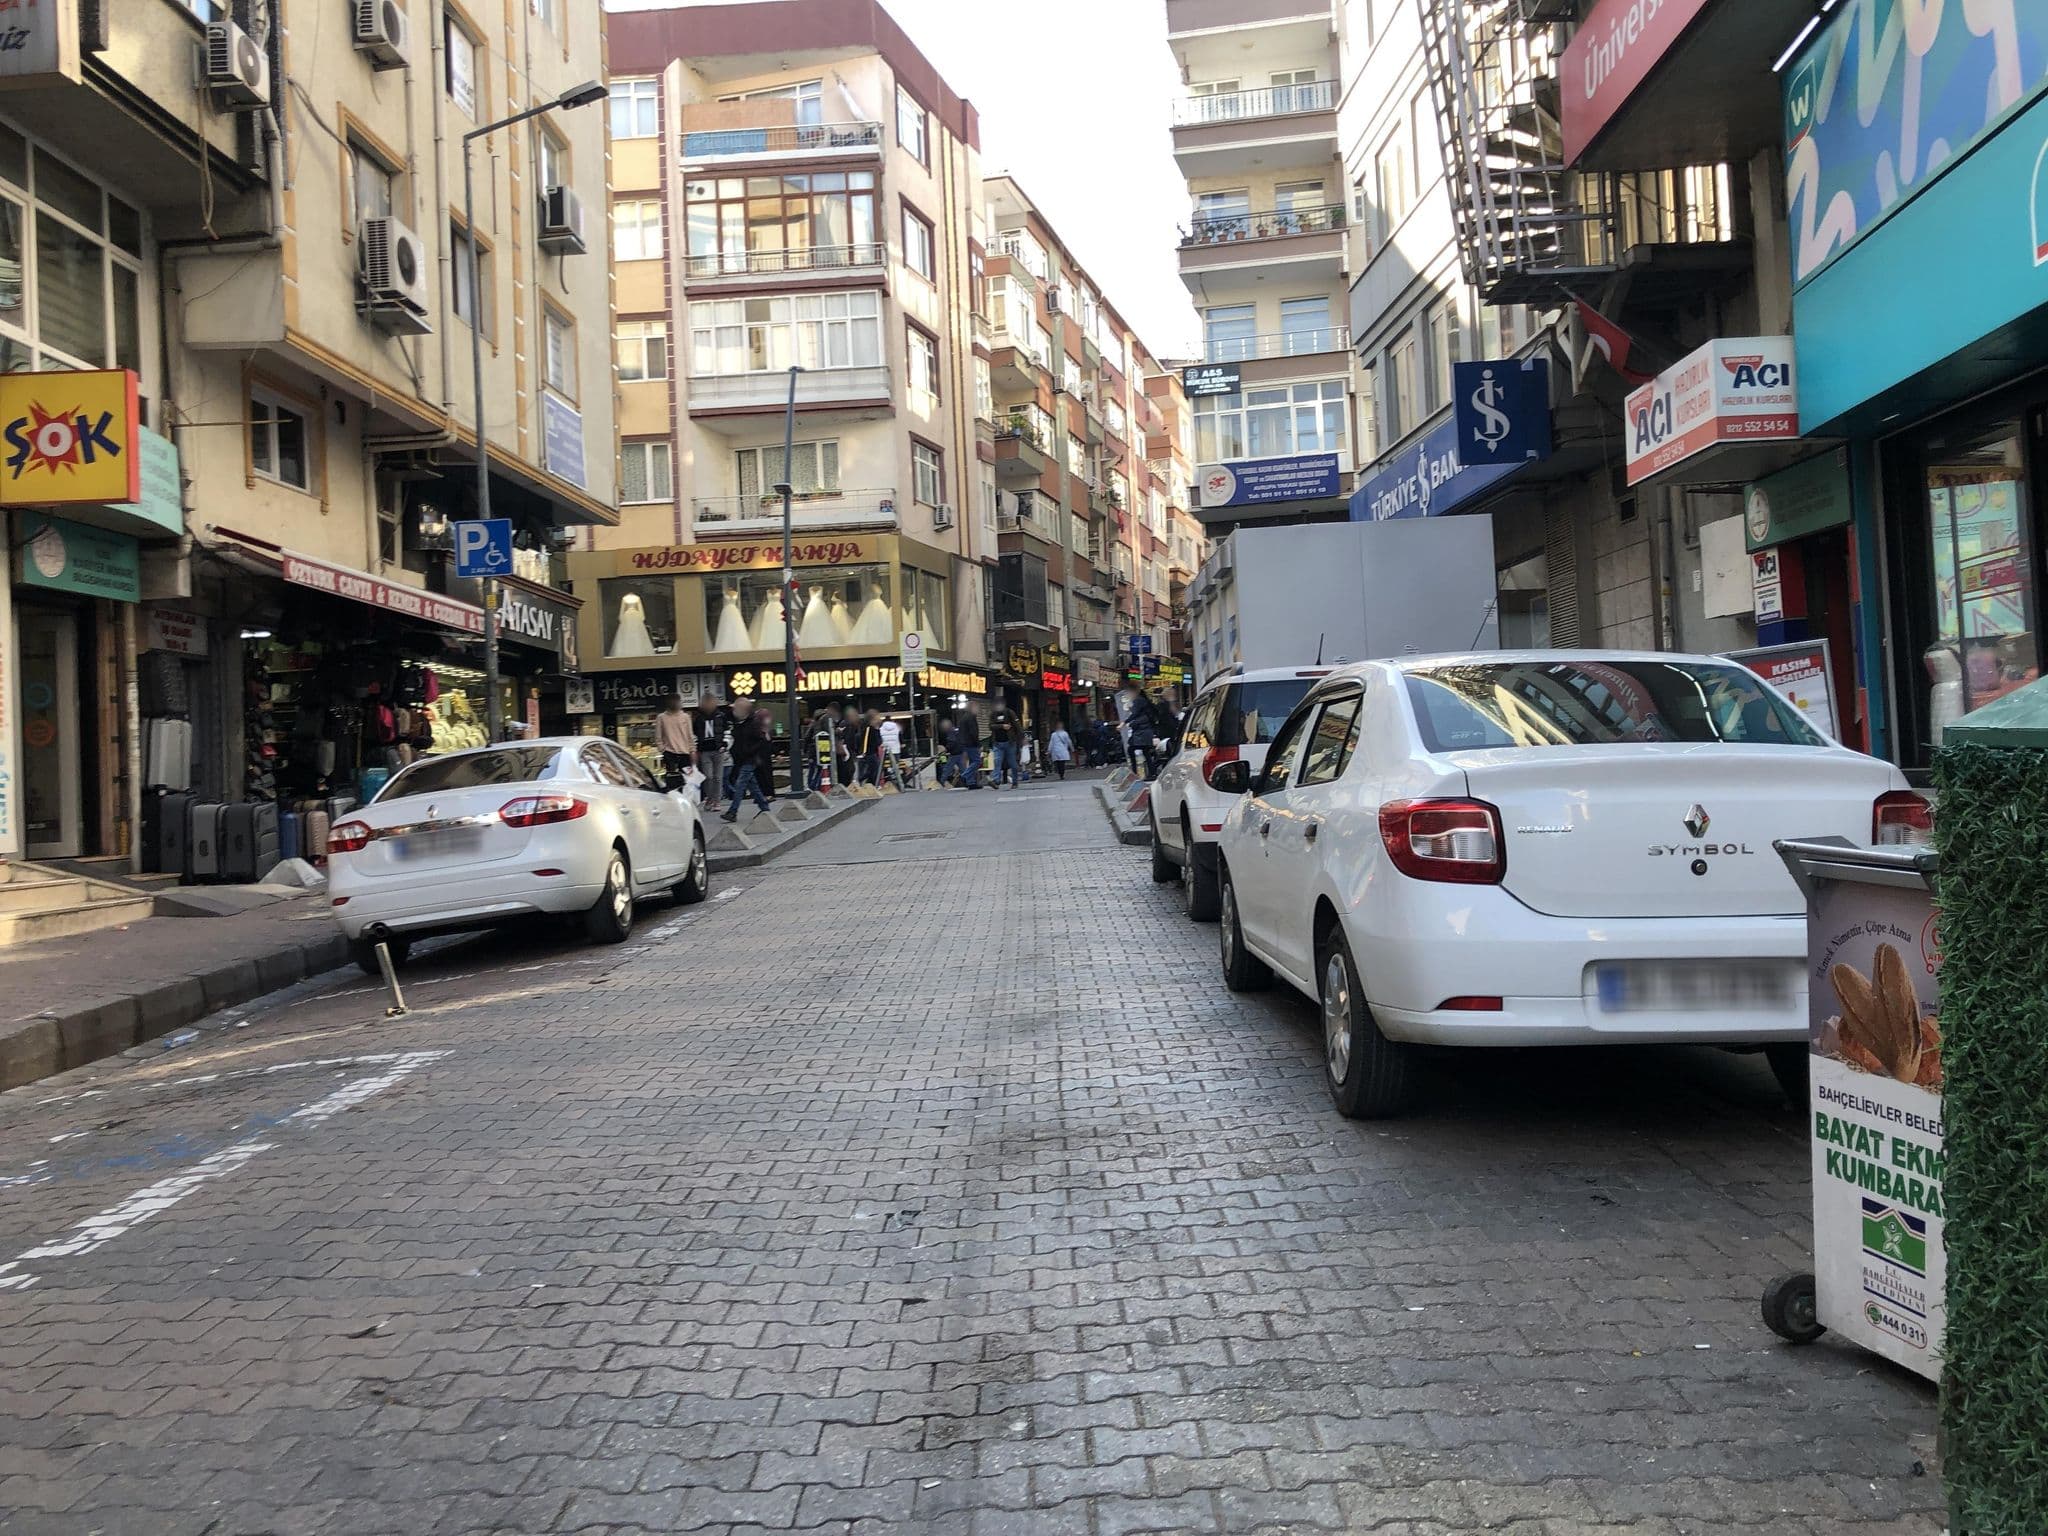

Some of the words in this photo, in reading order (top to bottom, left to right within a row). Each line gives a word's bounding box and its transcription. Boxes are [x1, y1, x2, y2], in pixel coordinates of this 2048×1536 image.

[1584, 0, 1663, 99] Ünivers
[1202, 368, 1223, 378] A&S
[1733, 363, 1790, 389] AÇI
[1635, 391, 1673, 454] AÇI
[1744, 421, 1761, 433] 552
[1763, 420, 1775, 431] 54
[1776, 420, 1789, 431] 54
[4, 410, 122, 480] ŞOK
[1371, 474, 1418, 521] TÜRKİYE
[459, 523, 490, 566] P
[632, 546, 759, 569] HİDAYET
[496, 589, 554, 641] ATASAY
[1771, 657, 1811, 676] KASIM
[600, 676, 669, 701] Hande
[761, 671, 860, 695] BALAVACI
[1648, 843, 1754, 856] SYMBOL
[1865, 920, 1888, 937] Çöpe
[1888, 923, 1912, 944] Atma
[1818, 1085, 1903, 1124] BAHÇELİEVLER
[1815, 1111, 1885, 1160] BAYAT
[1826, 1147, 1947, 1218] KUMBARA
[1882, 1314, 1900, 1331] 444
[1901, 1322, 1907, 1335] 0
[1908, 1326, 1926, 1344] 311
